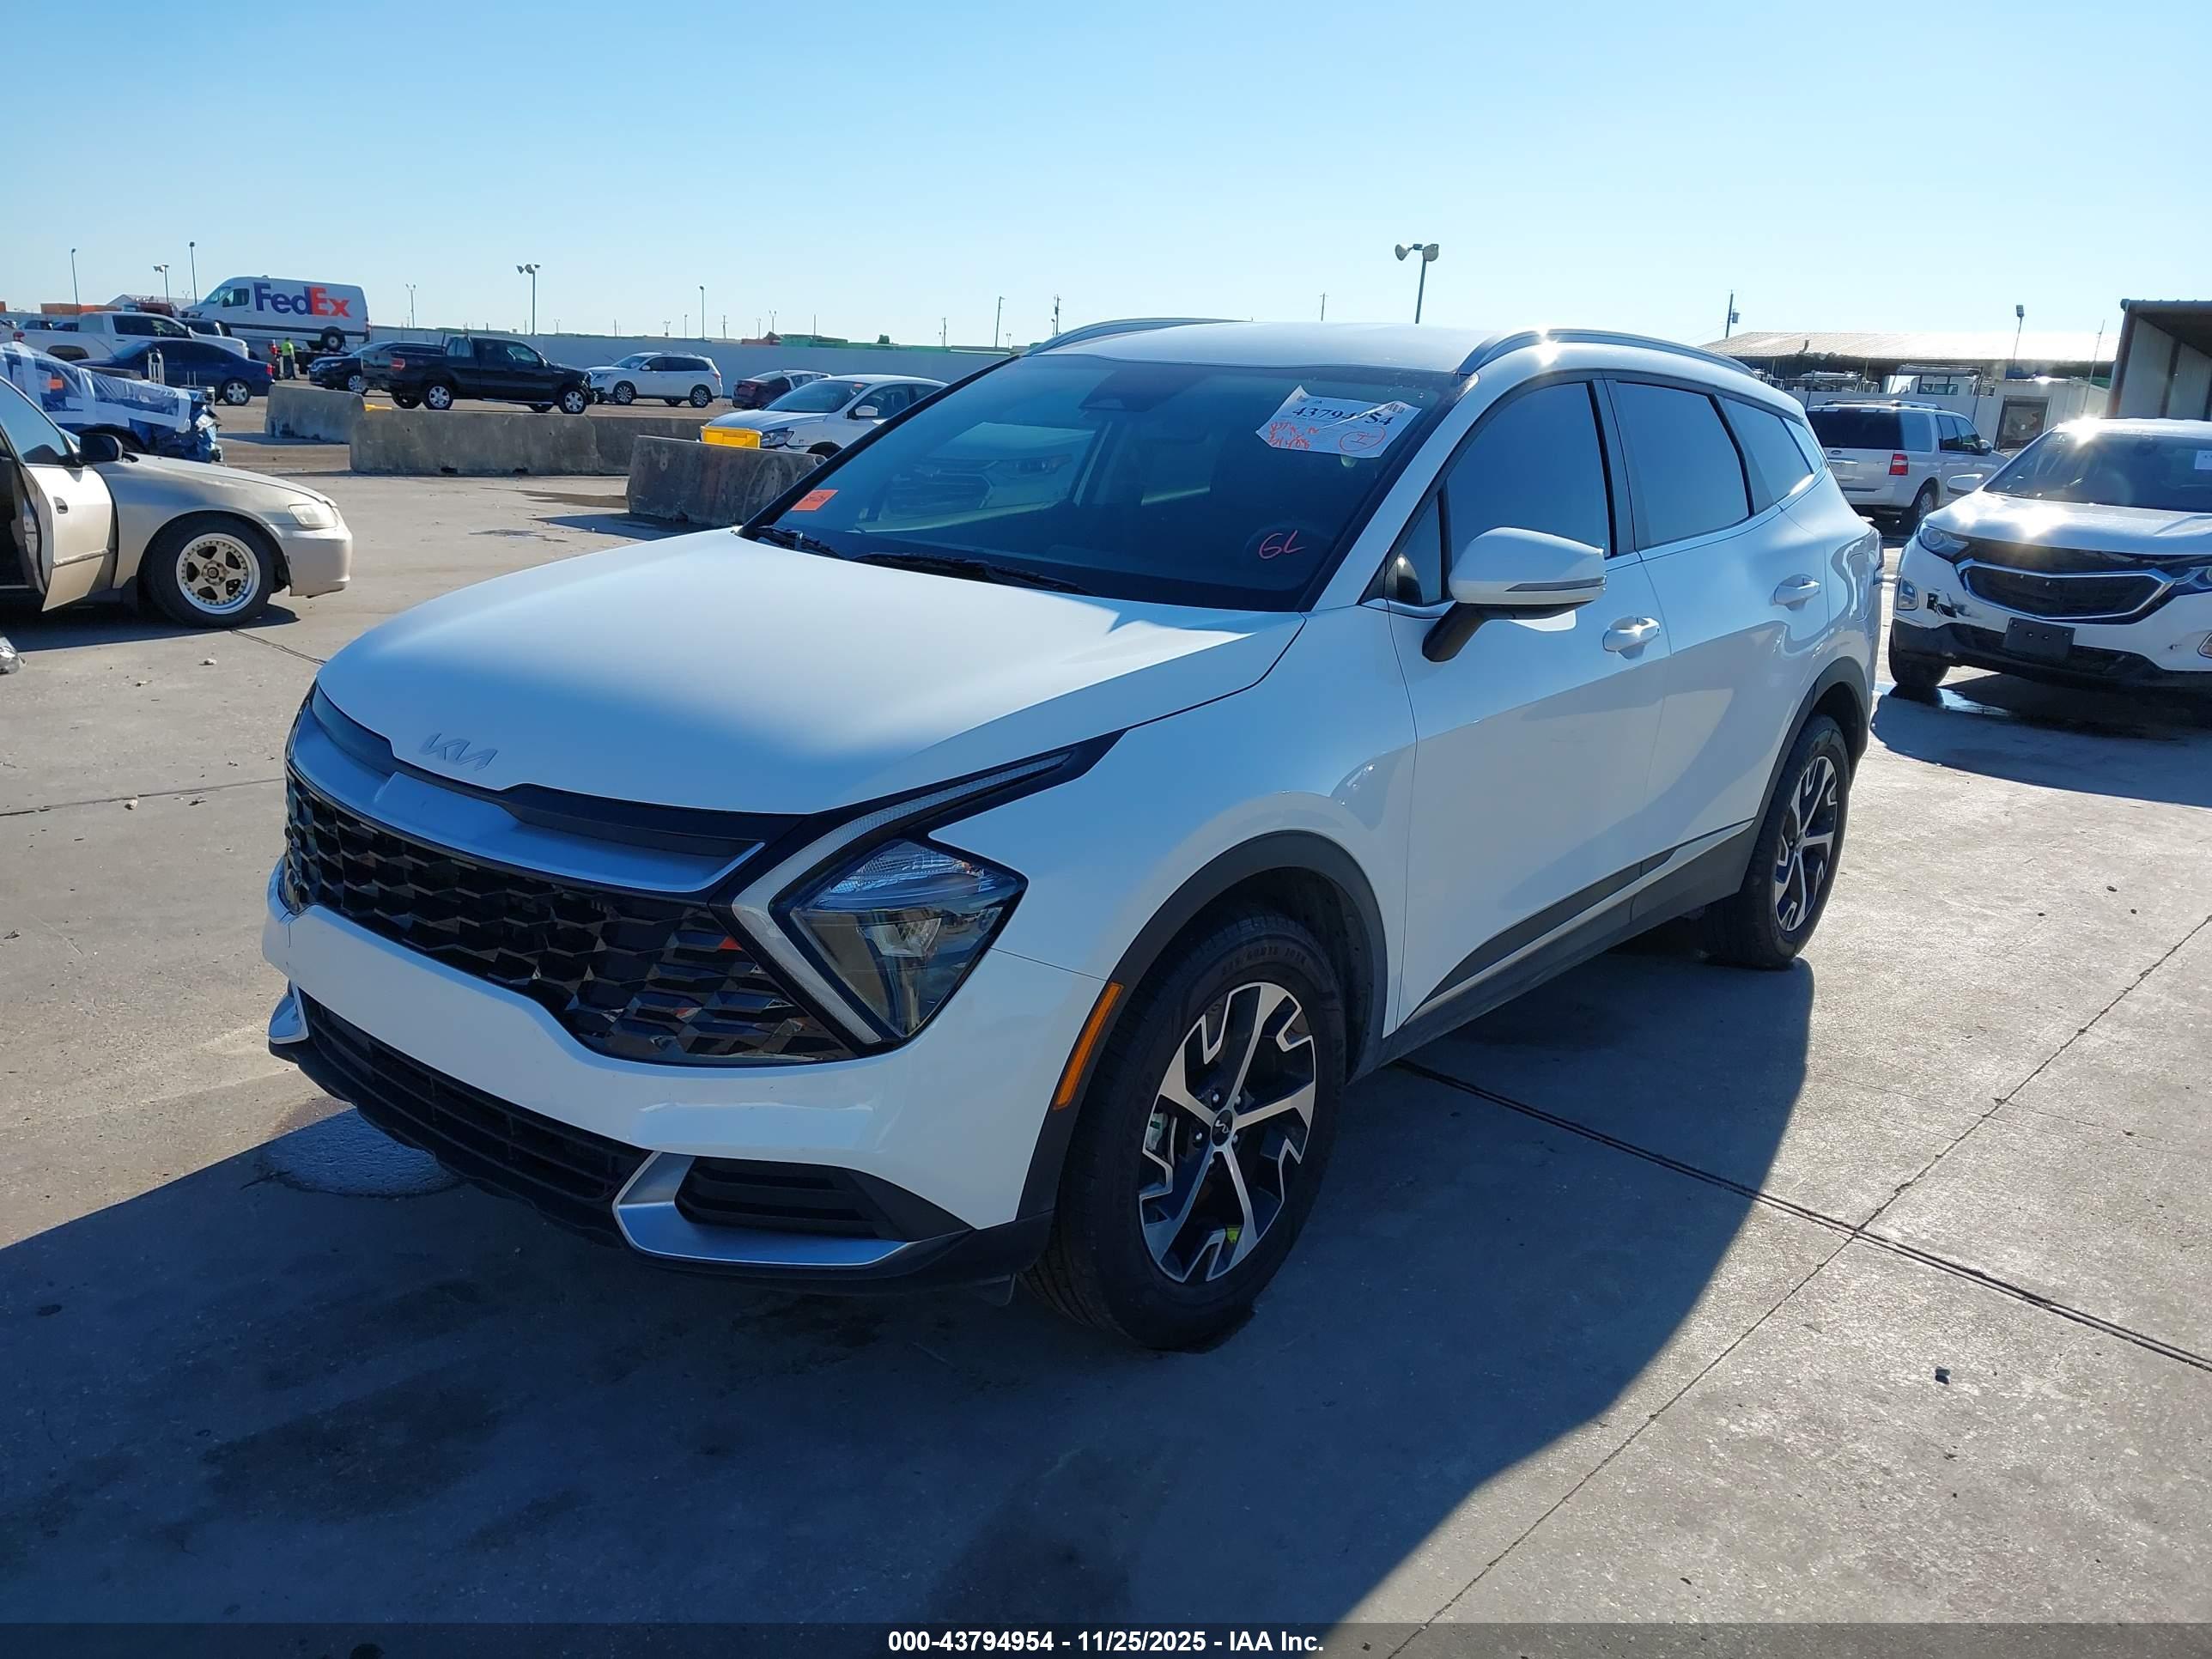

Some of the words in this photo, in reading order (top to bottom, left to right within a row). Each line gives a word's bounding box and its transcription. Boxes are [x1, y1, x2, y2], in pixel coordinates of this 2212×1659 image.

[253, 282, 351, 318] FedEx
[1292, 405, 1395, 427] 4379454
[419, 732, 499, 771] KIA
